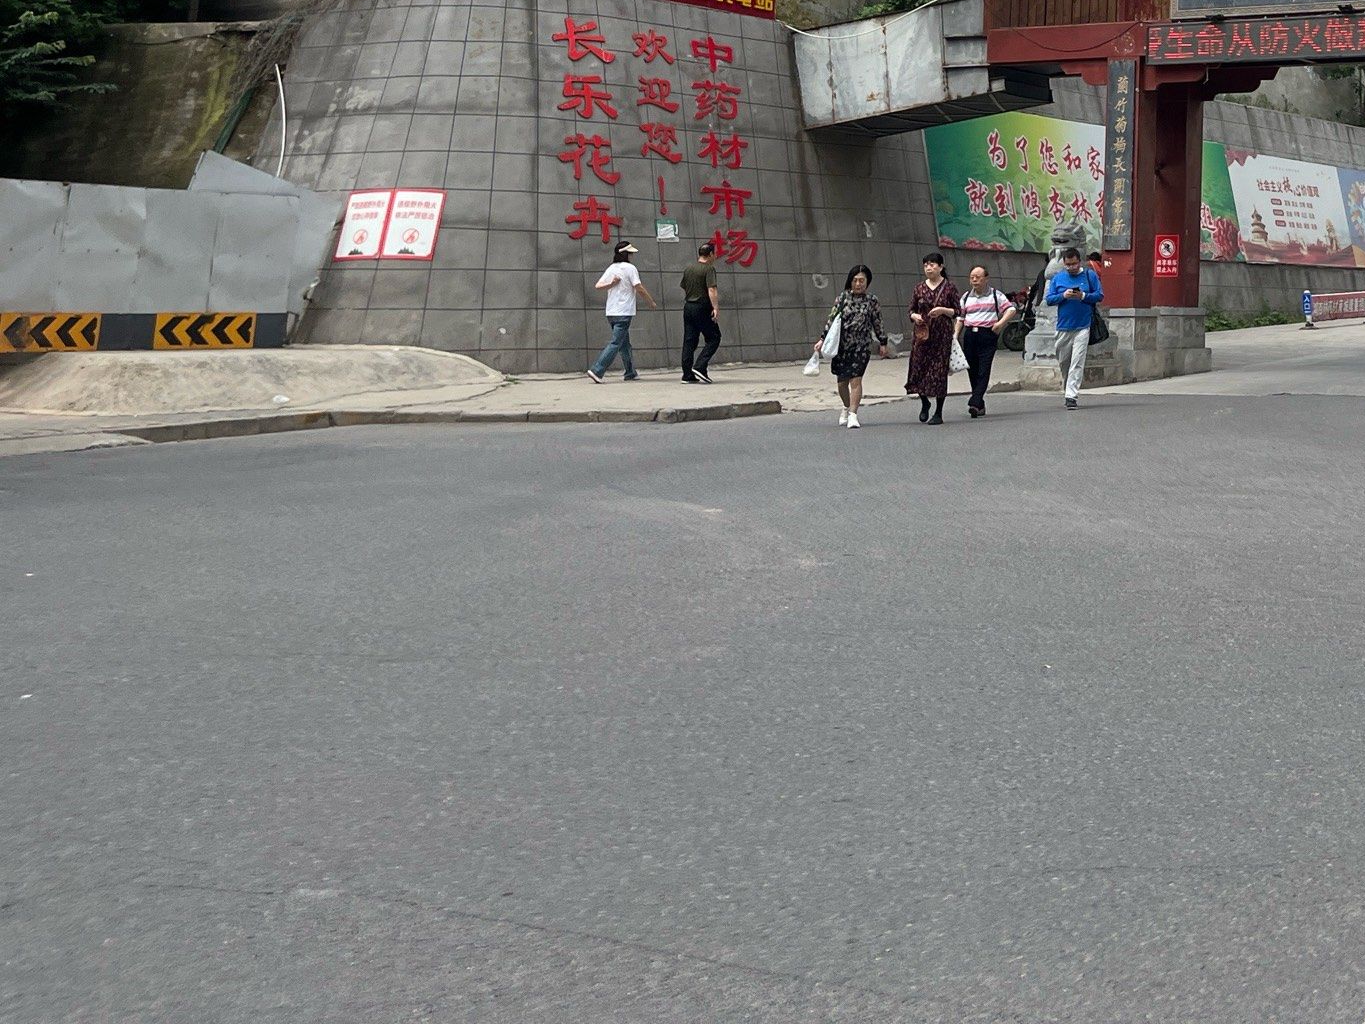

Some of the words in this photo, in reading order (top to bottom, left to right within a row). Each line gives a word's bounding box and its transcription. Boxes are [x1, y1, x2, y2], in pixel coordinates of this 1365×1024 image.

[551, 17, 624, 244] 长乐花卉
[690, 35, 760, 268] 中药材市场
